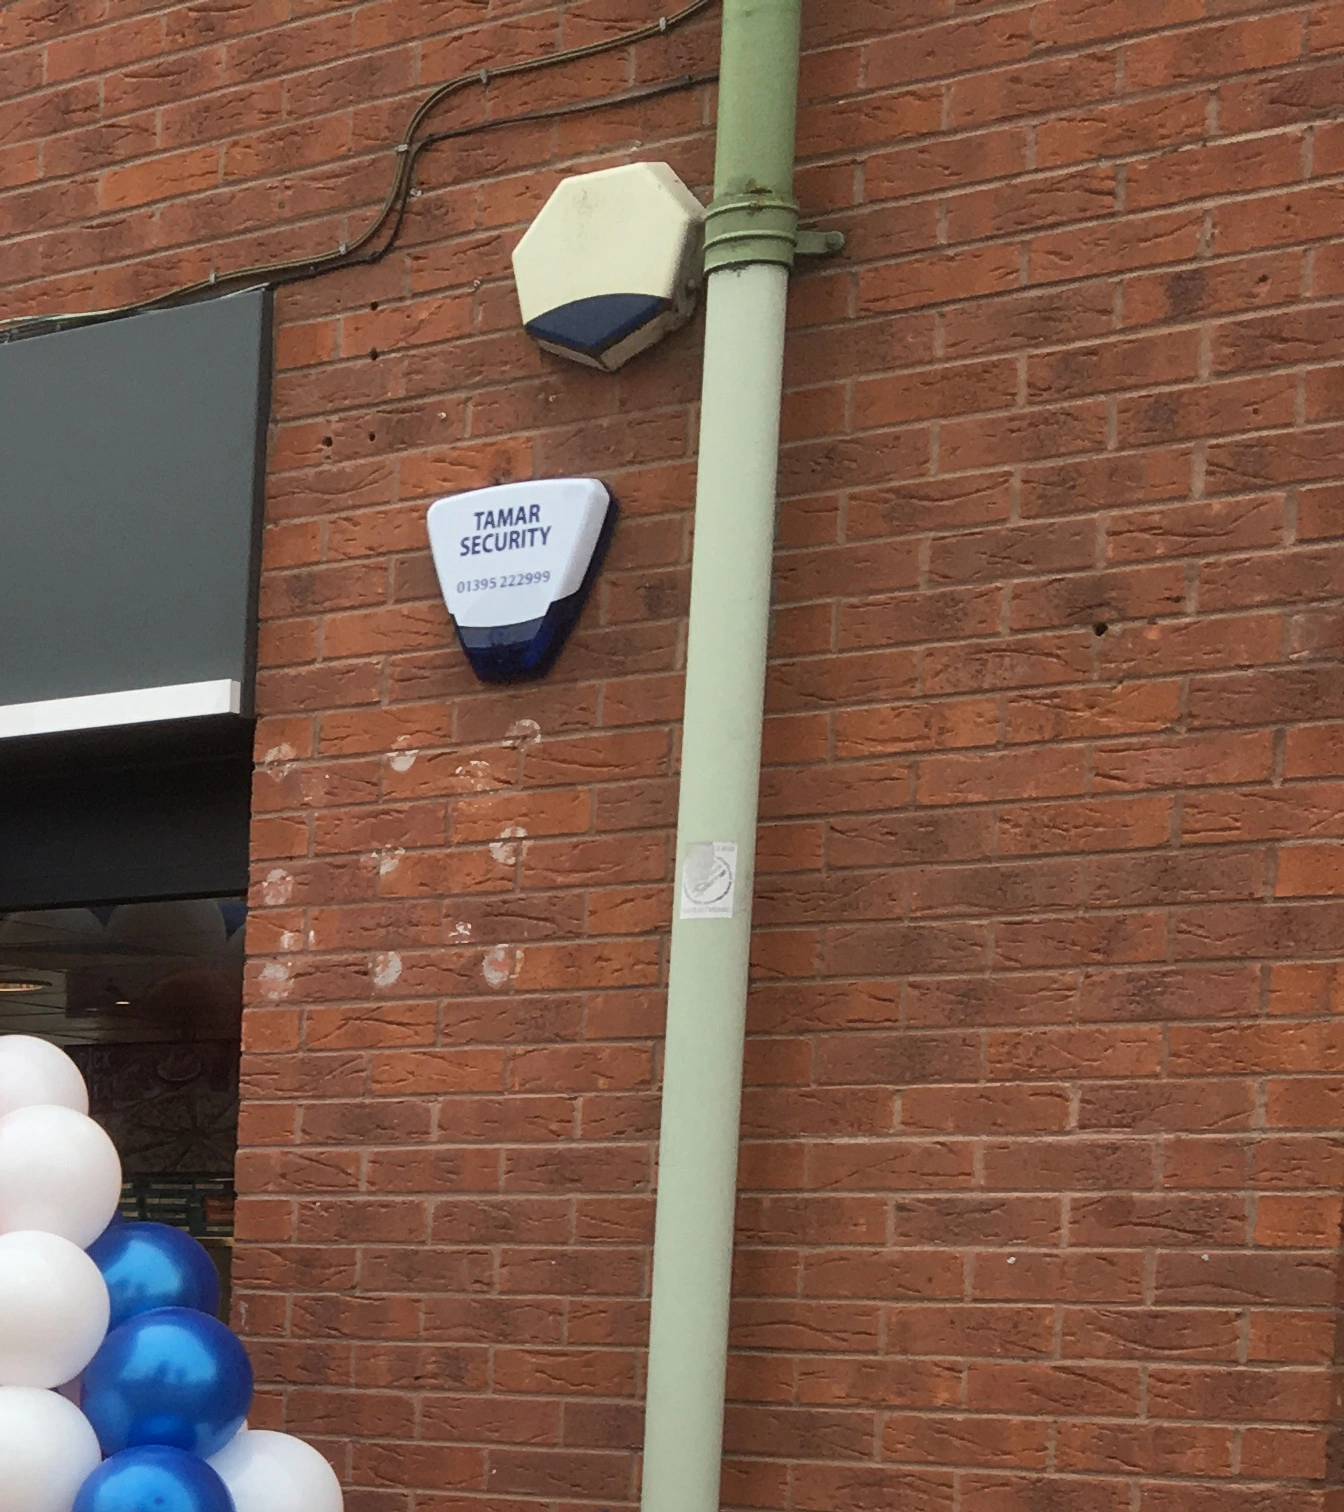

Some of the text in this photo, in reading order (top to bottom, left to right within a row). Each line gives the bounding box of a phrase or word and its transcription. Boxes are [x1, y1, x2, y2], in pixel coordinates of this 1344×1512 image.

[473, 503, 541, 532] TAMAR
[459, 525, 553, 557] SECURITY
[456, 570, 552, 594] 01395 222999
